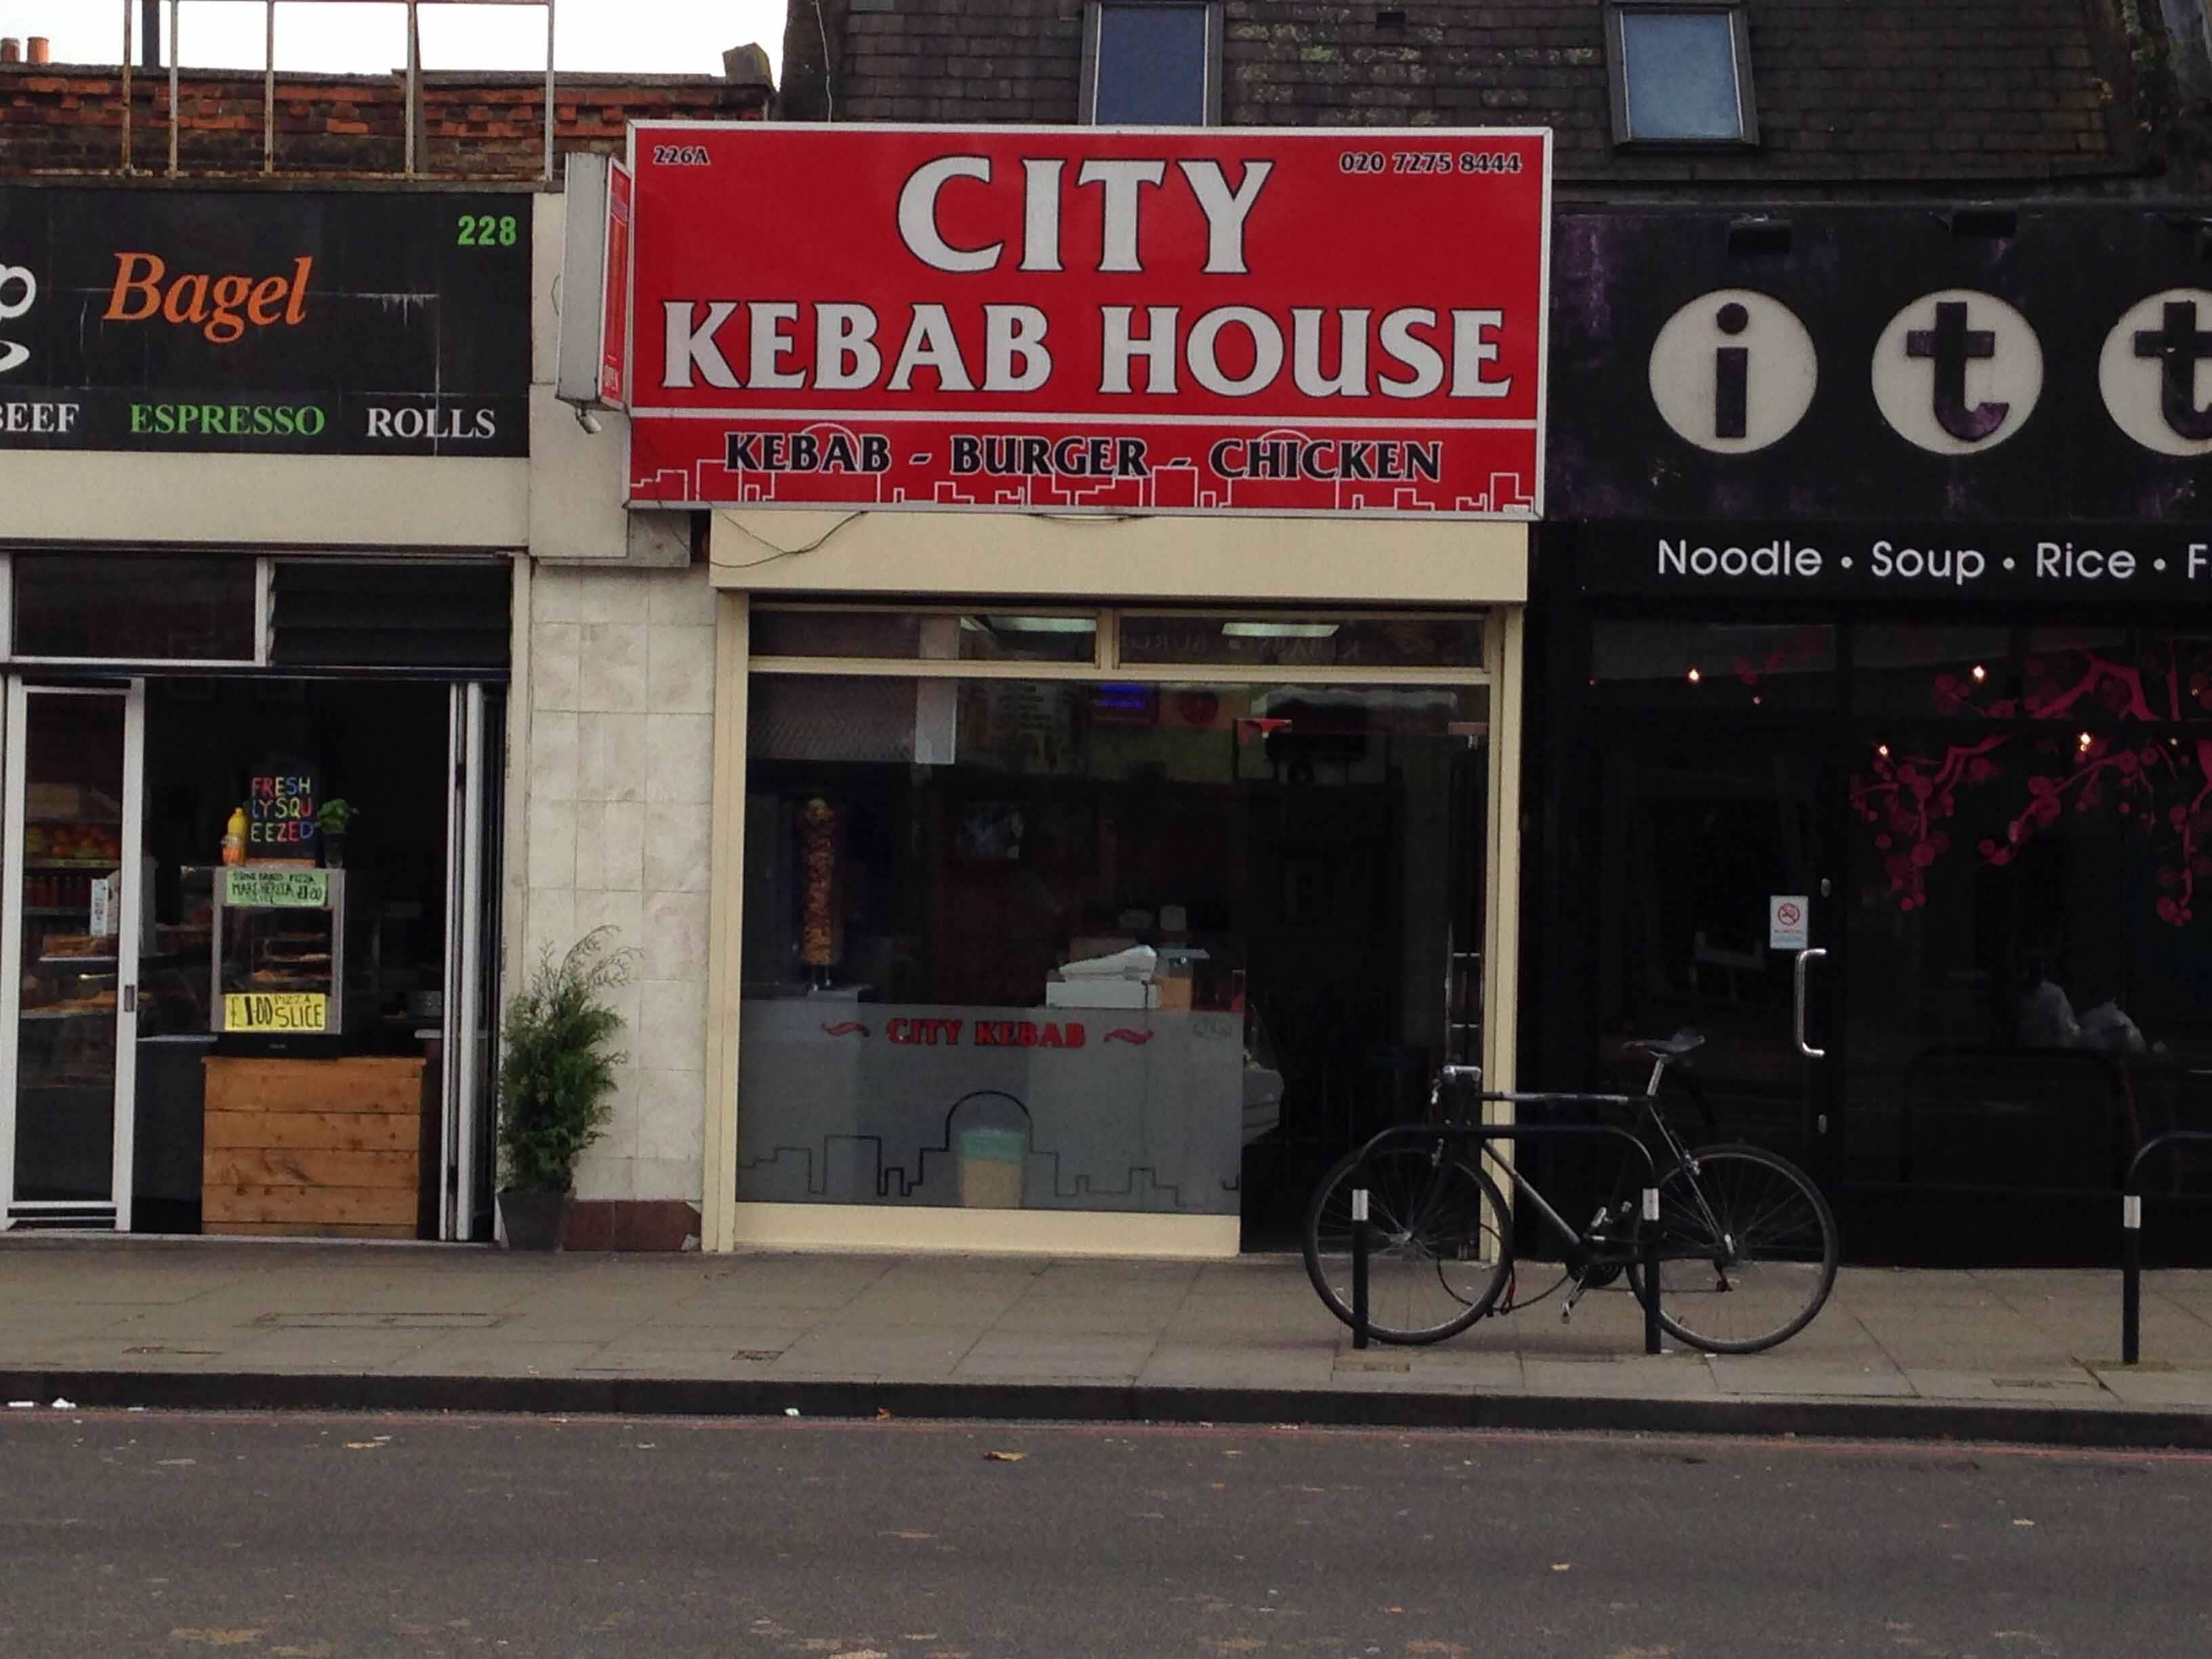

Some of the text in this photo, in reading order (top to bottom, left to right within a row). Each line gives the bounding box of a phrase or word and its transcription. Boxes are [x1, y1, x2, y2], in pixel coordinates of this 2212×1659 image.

[653, 146, 710, 166] 226A
[1339, 152, 1522, 173] 020 7275 8444
[897, 155, 1274, 274] CITY
[457, 215, 517, 246] 228
[103, 252, 313, 344] Bagel
[661, 300, 1513, 399] KEBAB HOUSE
[0, 403, 497, 438] EEF ESPRESSO ROLLS
[724, 433, 892, 474] KEBAB
[949, 435, 1152, 478] BURGER
[1208, 438, 1443, 482] CHICKEN
[1658, 539, 1822, 576] Noodle
[1871, 541, 1985, 586] Soup
[2036, 542, 2136, 578] Rice
[251, 777, 311, 797] FRESH
[274, 995, 310, 1004] PIZZA
[275, 1004, 323, 1027] SLICE
[885, 1018, 1086, 1048] CITY KEBAB
